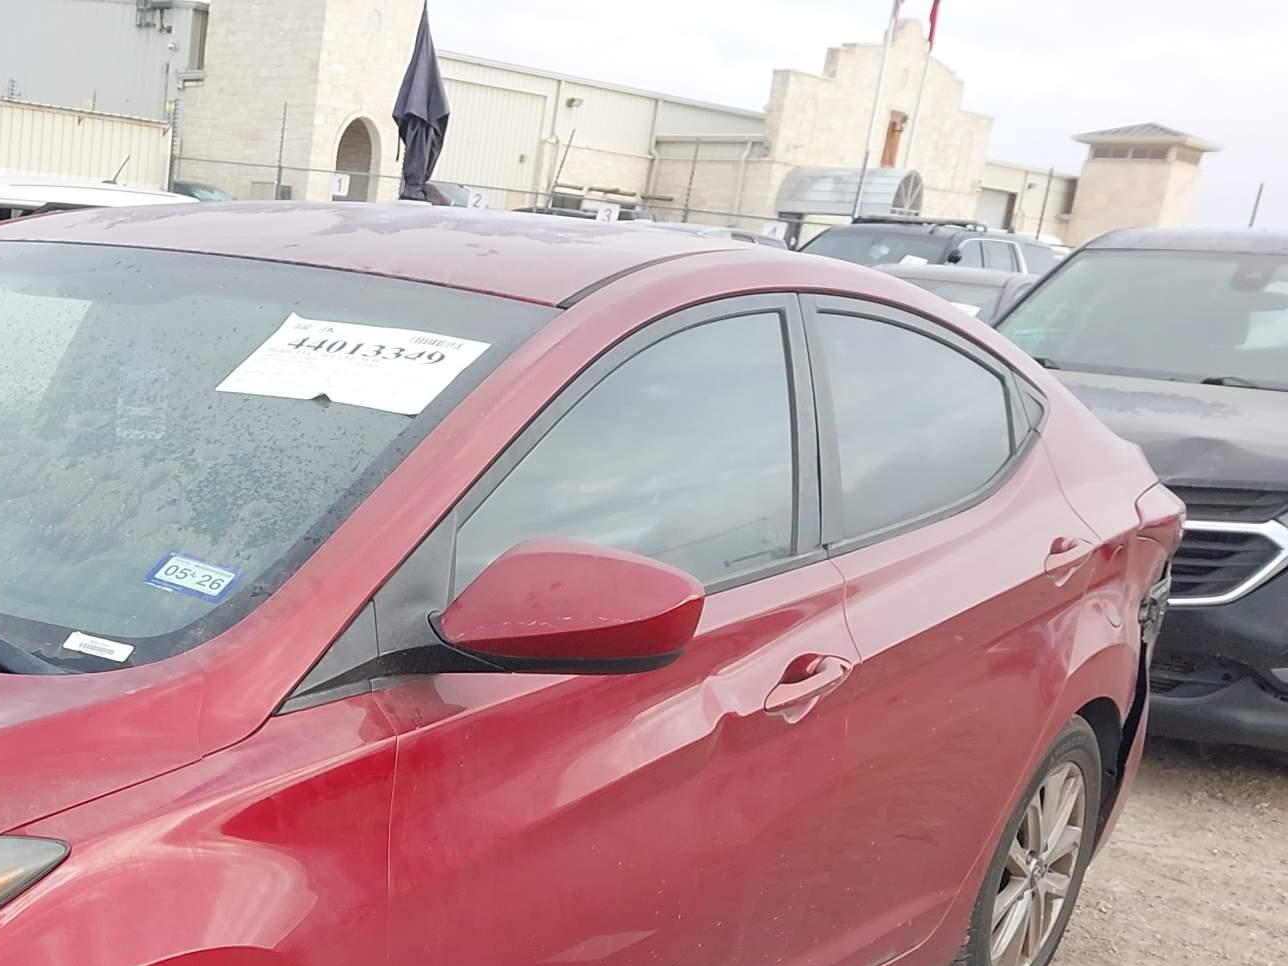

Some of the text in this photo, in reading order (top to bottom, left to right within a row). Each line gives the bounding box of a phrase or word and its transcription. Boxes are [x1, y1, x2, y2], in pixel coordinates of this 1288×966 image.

[472, 193, 483, 208] 2
[602, 208, 613, 222] 3
[287, 336, 446, 365] 44013349
[164, 564, 225, 591] 05 26
